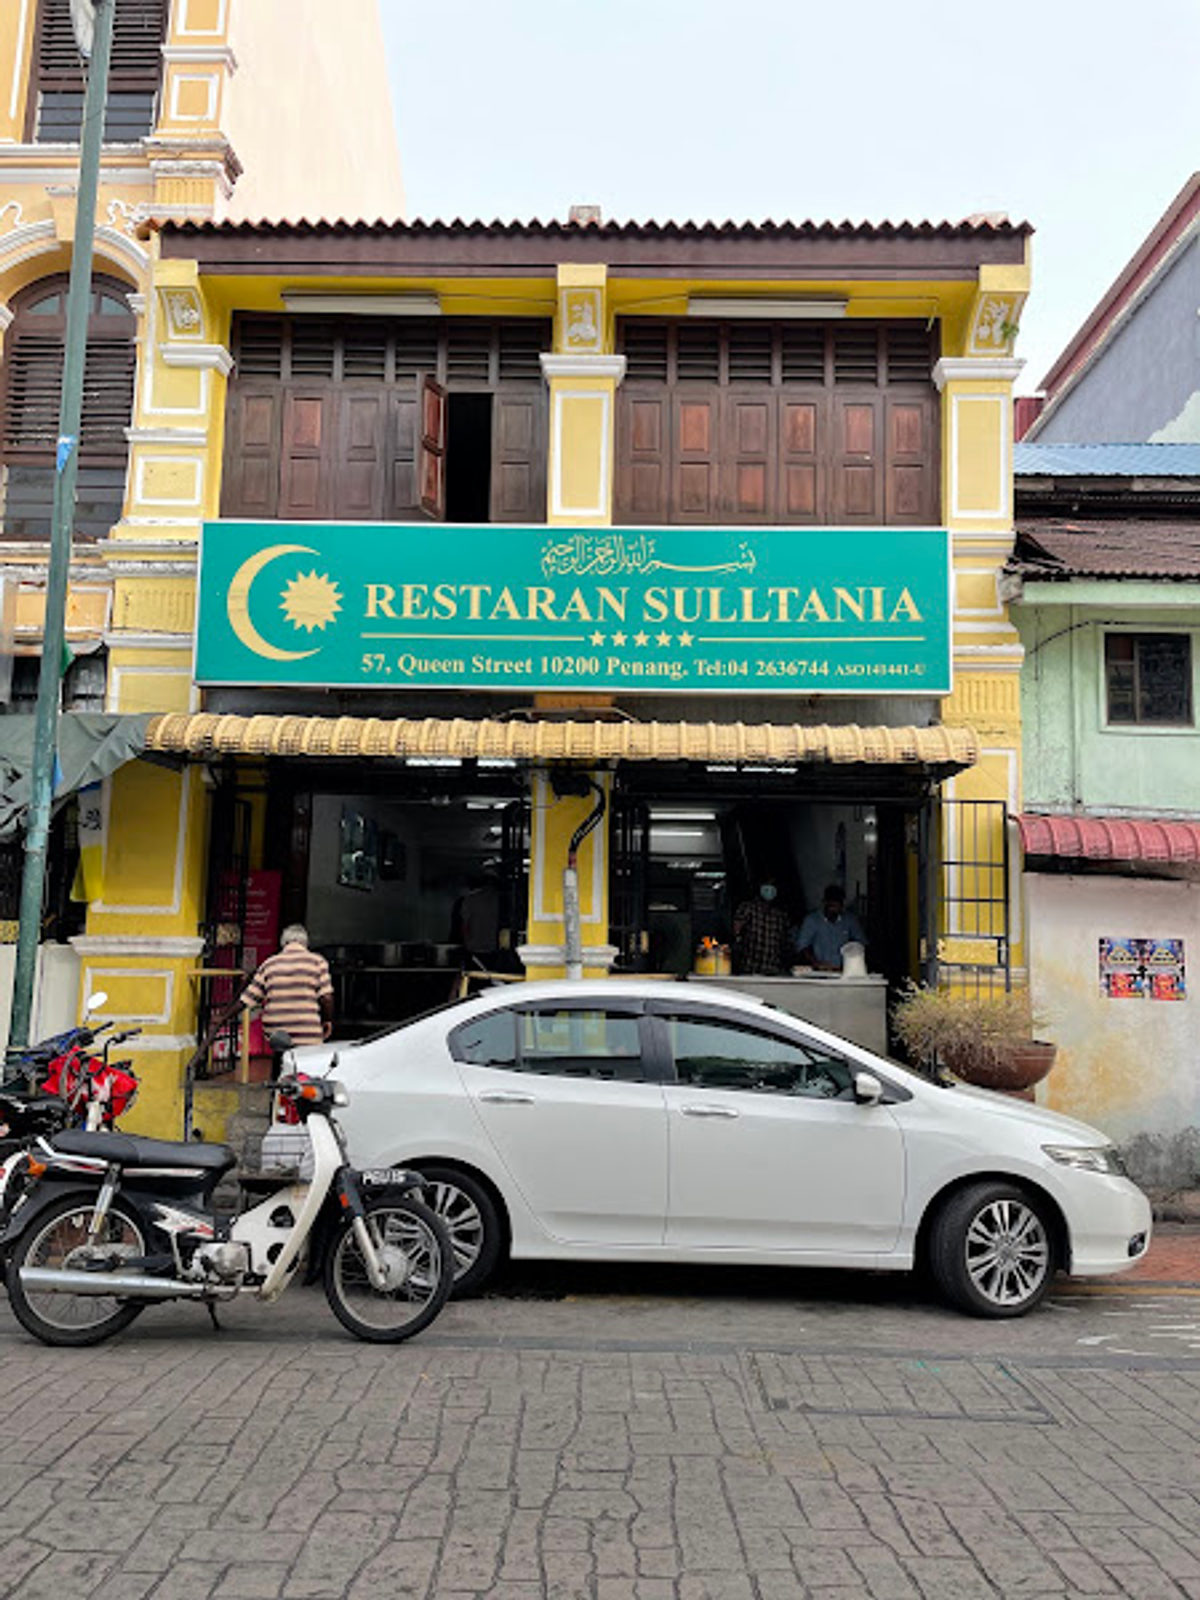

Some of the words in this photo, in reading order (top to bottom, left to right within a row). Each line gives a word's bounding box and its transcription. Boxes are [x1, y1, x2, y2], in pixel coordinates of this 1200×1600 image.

[364, 583, 629, 623] RESTARAN
[643, 586, 925, 623] SULLTANIA
[361, 654, 391, 674] 57,
[398, 654, 465, 675] Queen
[471, 655, 533, 675] Street
[540, 657, 601, 676] 10200
[694, 659, 748, 676] Tel:04
[755, 660, 830, 677] 2636744
